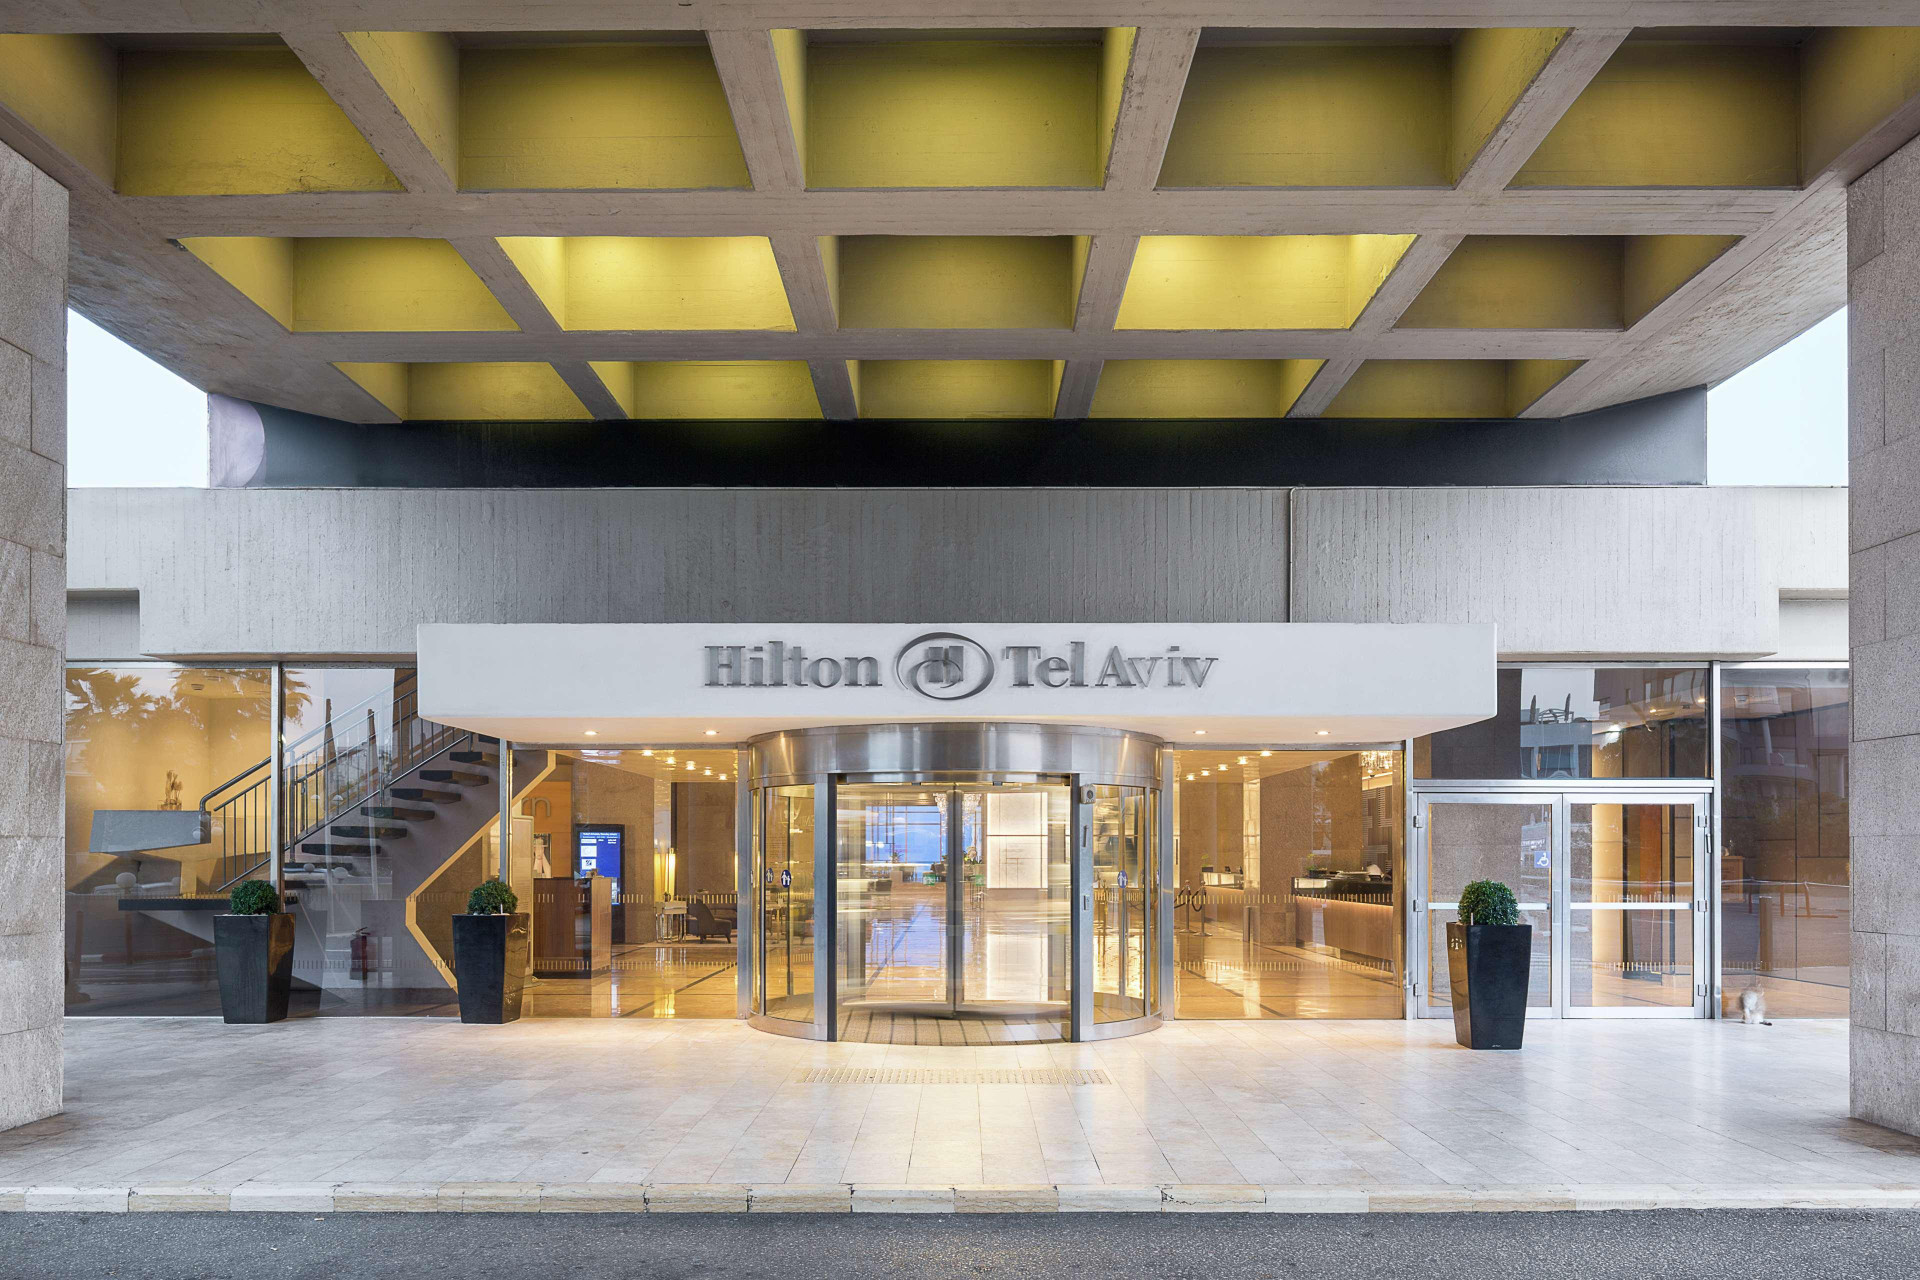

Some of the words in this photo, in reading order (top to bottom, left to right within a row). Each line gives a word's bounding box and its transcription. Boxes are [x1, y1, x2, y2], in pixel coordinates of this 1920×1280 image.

[704, 640, 883, 688] Hilton
[1005, 641, 1088, 687] Tel
[1095, 645, 1219, 688] Aviv
